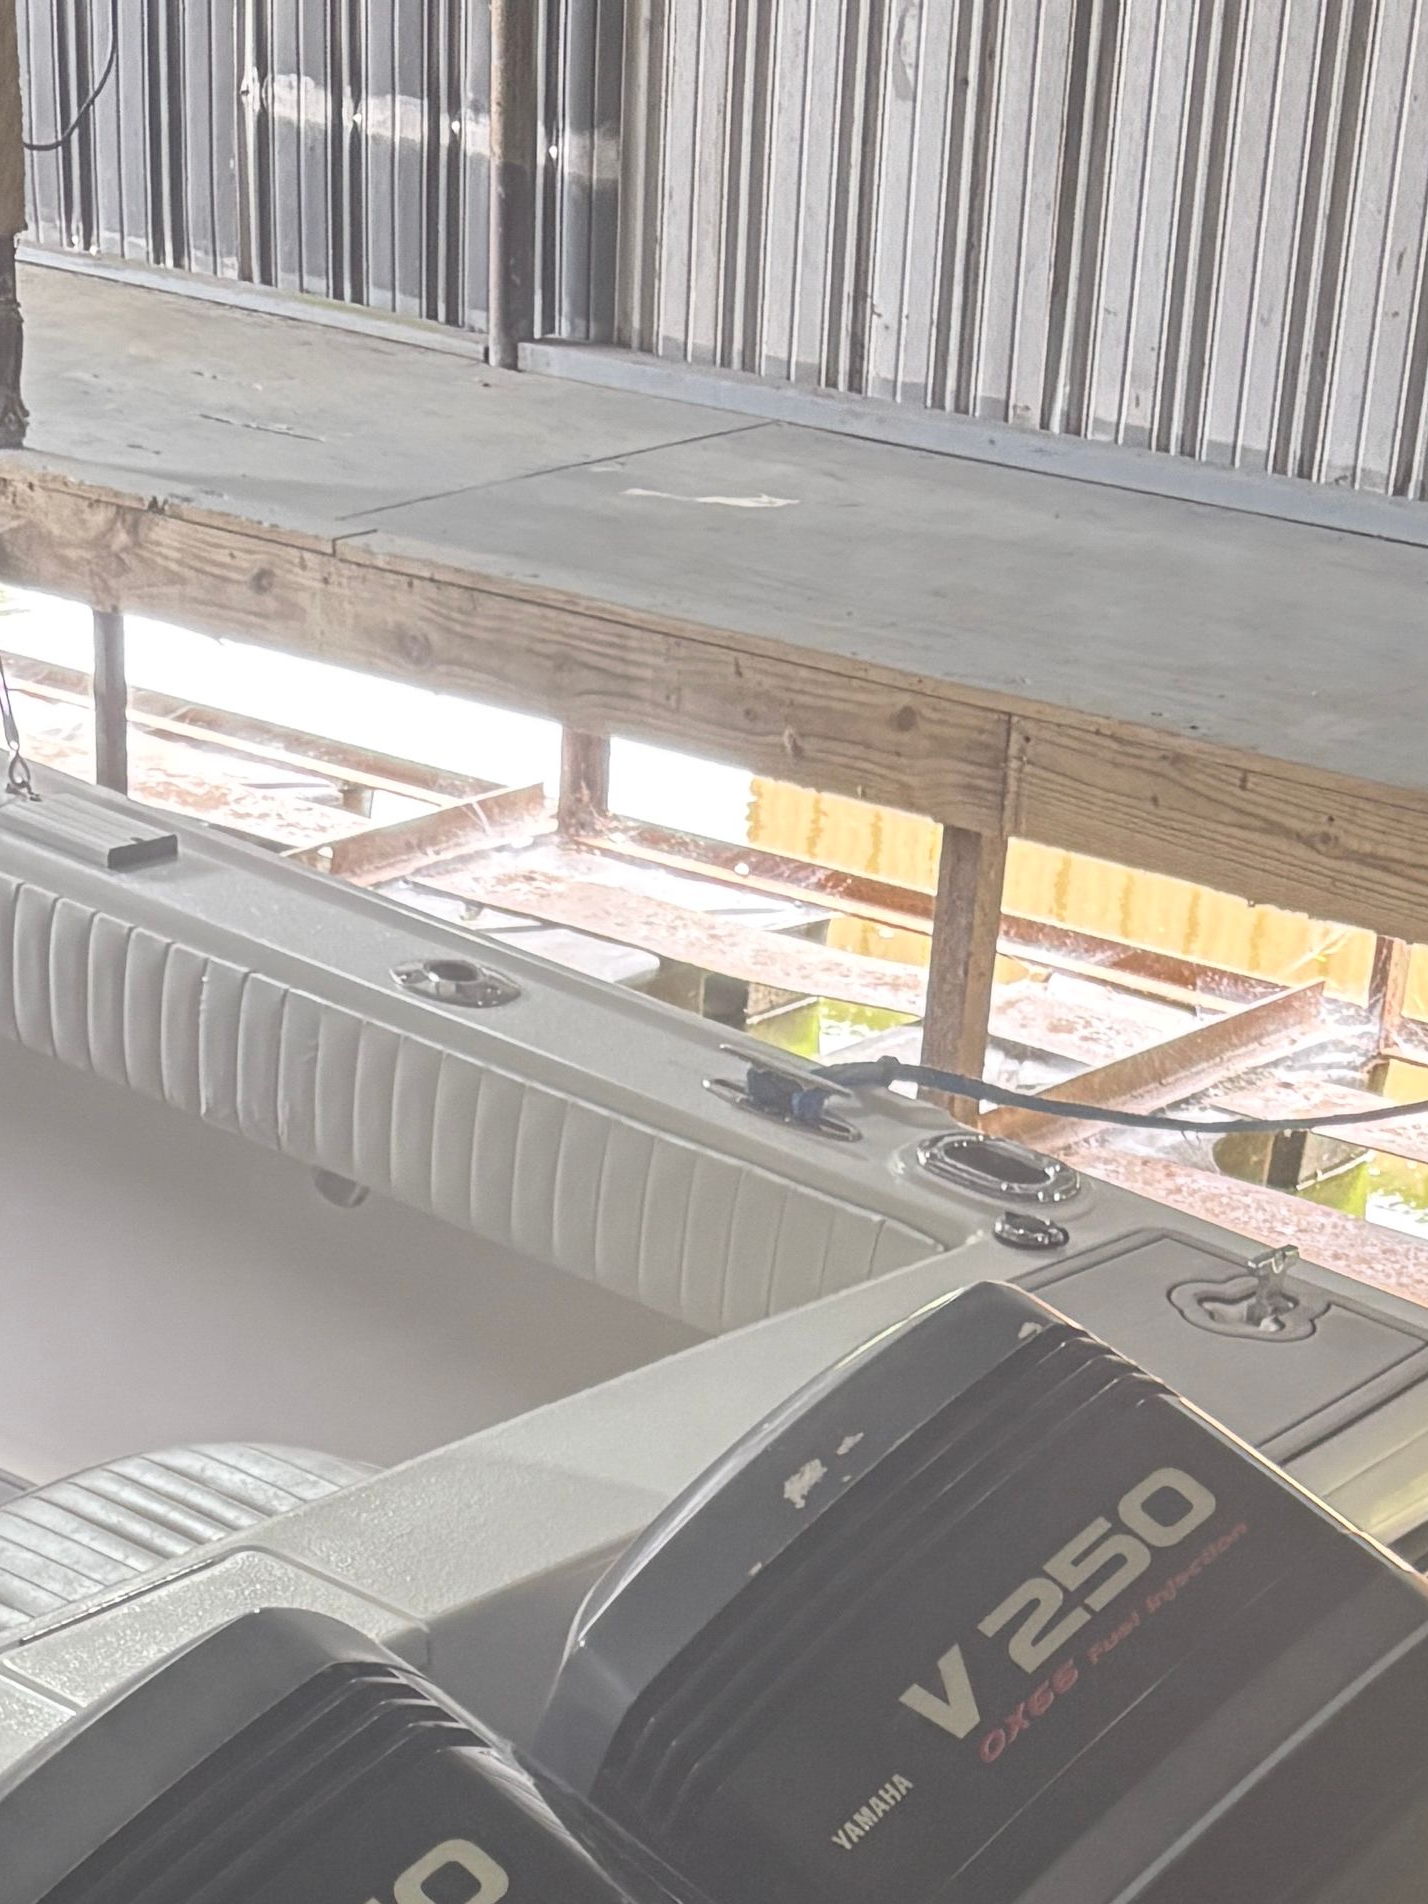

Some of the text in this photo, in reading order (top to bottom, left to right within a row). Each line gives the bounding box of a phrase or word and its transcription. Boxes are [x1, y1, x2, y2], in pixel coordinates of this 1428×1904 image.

[898, 1467, 1216, 1740] V 250
[980, 1658, 1079, 1763] OX66
[830, 1772, 914, 1851] YAMAHA
